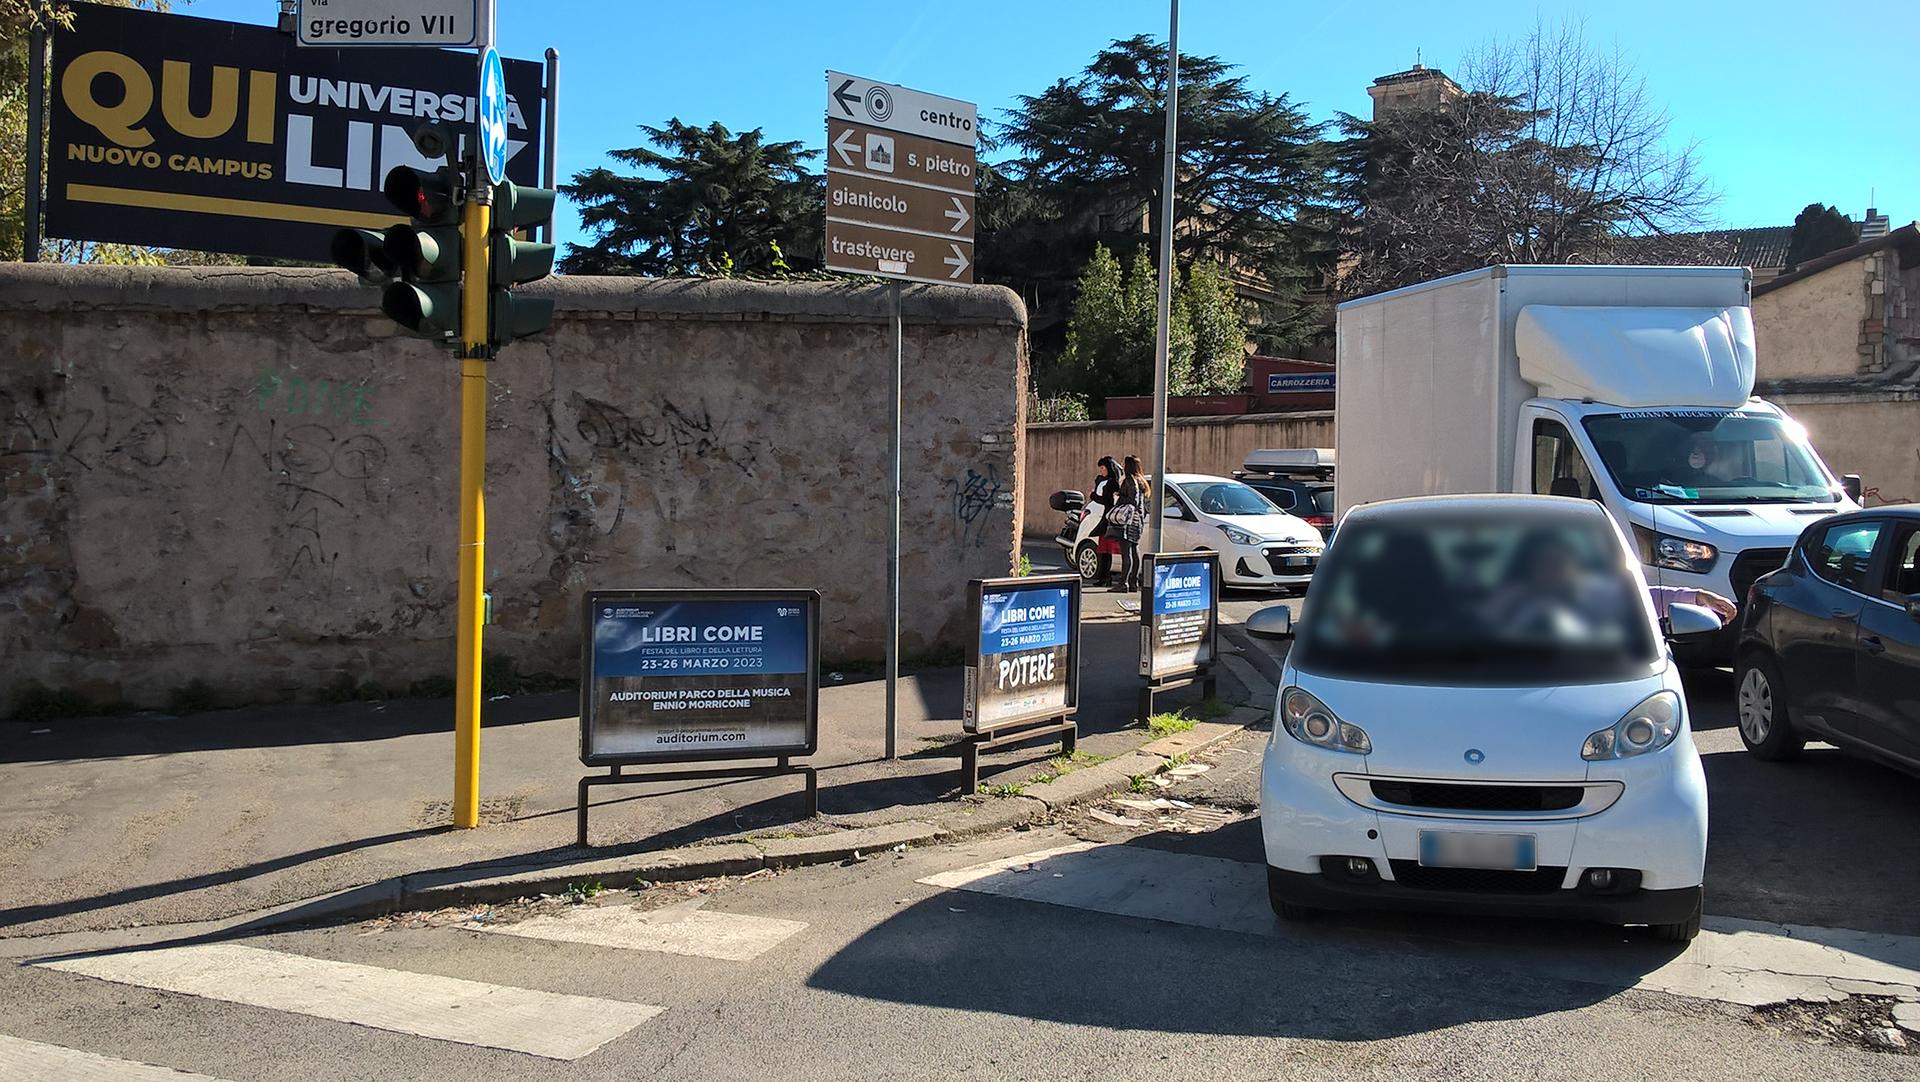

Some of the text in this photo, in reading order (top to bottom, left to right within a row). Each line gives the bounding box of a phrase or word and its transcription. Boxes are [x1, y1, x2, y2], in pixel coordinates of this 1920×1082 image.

[310, 16, 455, 38] gregorio VII
[62, 50, 277, 148] QUI
[289, 75, 528, 130] UNIVERSIÀ
[920, 109, 971, 131] centro
[67, 143, 273, 180] NUOVO CAMPUS
[908, 153, 970, 177] s. pietro
[832, 187, 908, 213] gianicolo
[831, 236, 916, 263] trastevere
[1271, 378, 1330, 387] CARROZZERIA
[1165, 576, 1201, 589] LIBRI COME
[1001, 605, 1056, 624] LIBRI COME
[642, 626, 763, 642] LIBRI COME
[1001, 637, 1019, 647] 23-26
[1019, 634, 1041, 645] MARZO
[641, 657, 763, 669] 23-26 MARZO 2023
[998, 652, 1055, 690] POTERE
[609, 688, 791, 702] AUDITORIUM PARCO DELLA MUSICA
[653, 699, 751, 711] ENNIO MORRICONE
[656, 732, 746, 744] auditorium.com
